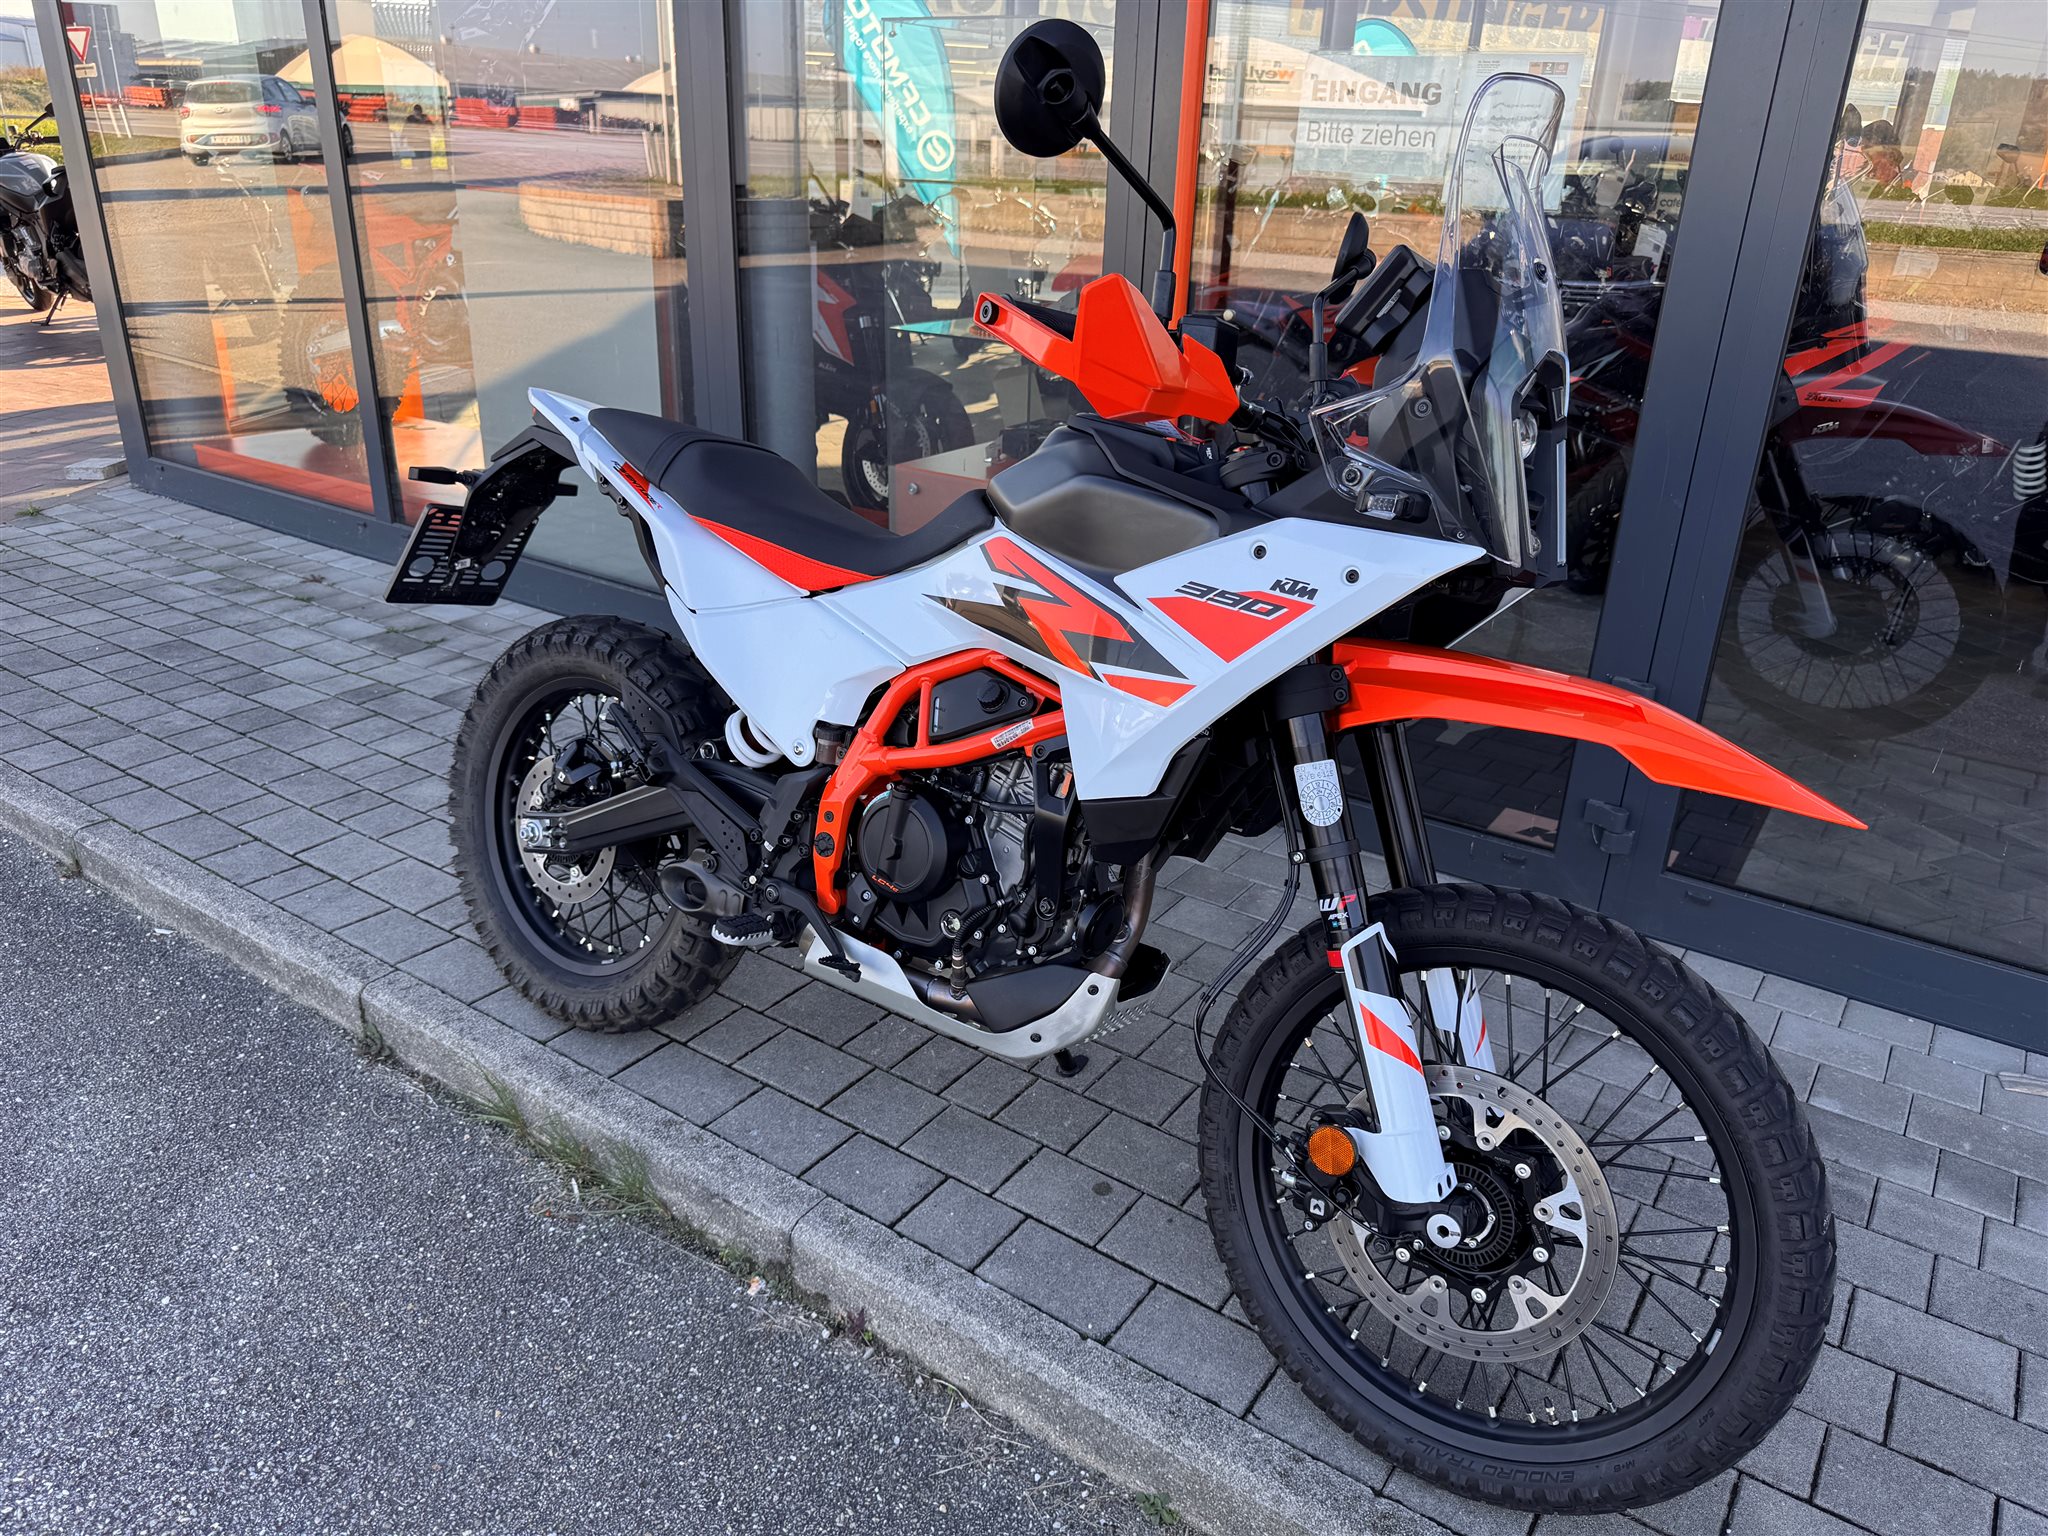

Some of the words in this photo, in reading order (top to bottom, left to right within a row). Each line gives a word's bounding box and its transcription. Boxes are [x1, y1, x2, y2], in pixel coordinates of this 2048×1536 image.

[1311, 80, 1443, 106] EINGANG
[1306, 120, 1354, 144] Bitte
[1360, 123, 1436, 148] ziehen
[1174, 580, 1289, 619] 390
[1269, 577, 1319, 601] KTM
[1320, 894, 1357, 911] WP
[1404, 1437, 1475, 1470] TRAIL+
[1481, 1464, 1575, 1484] ENDURO
